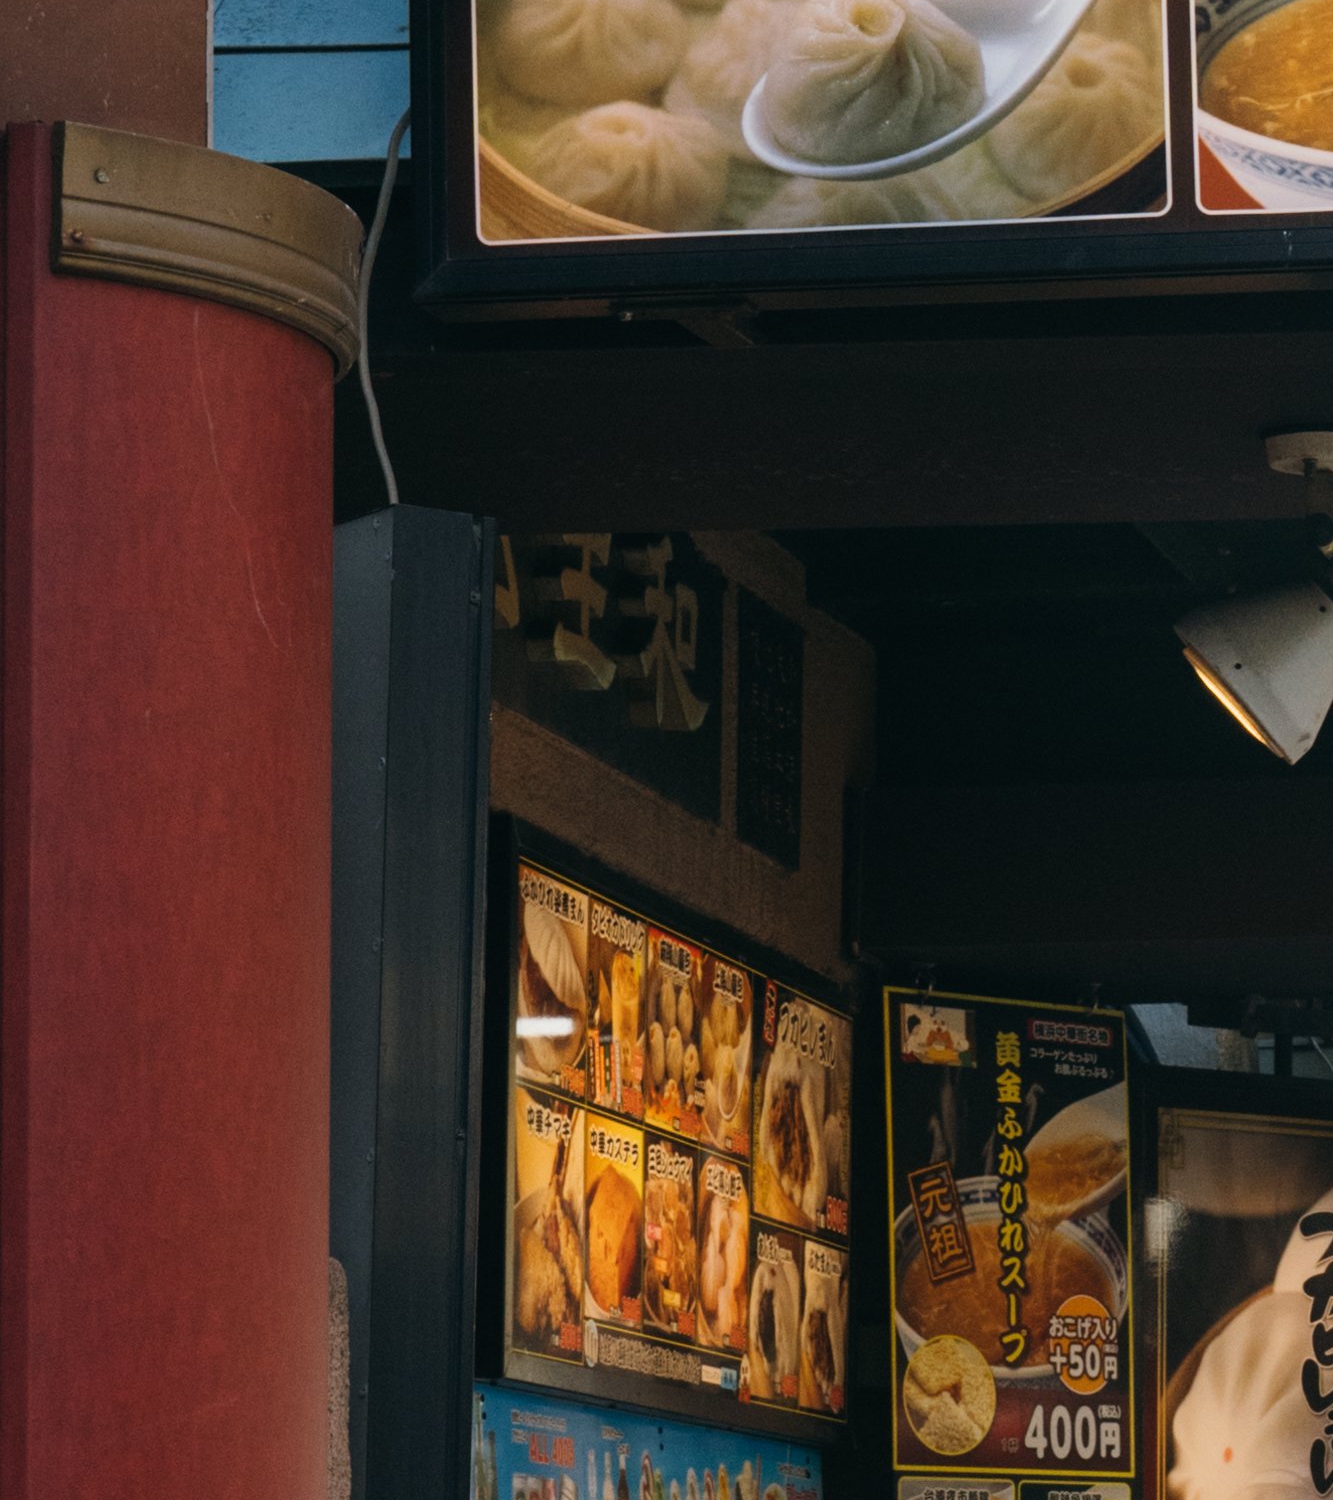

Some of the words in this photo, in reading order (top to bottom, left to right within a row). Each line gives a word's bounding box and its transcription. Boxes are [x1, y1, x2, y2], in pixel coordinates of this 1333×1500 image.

[995, 1030, 1029, 1366] 黄金ふかひれスープ
[1049, 1315, 1119, 1342] おこげ入り
[1023, 1404, 1122, 1461] 400円
